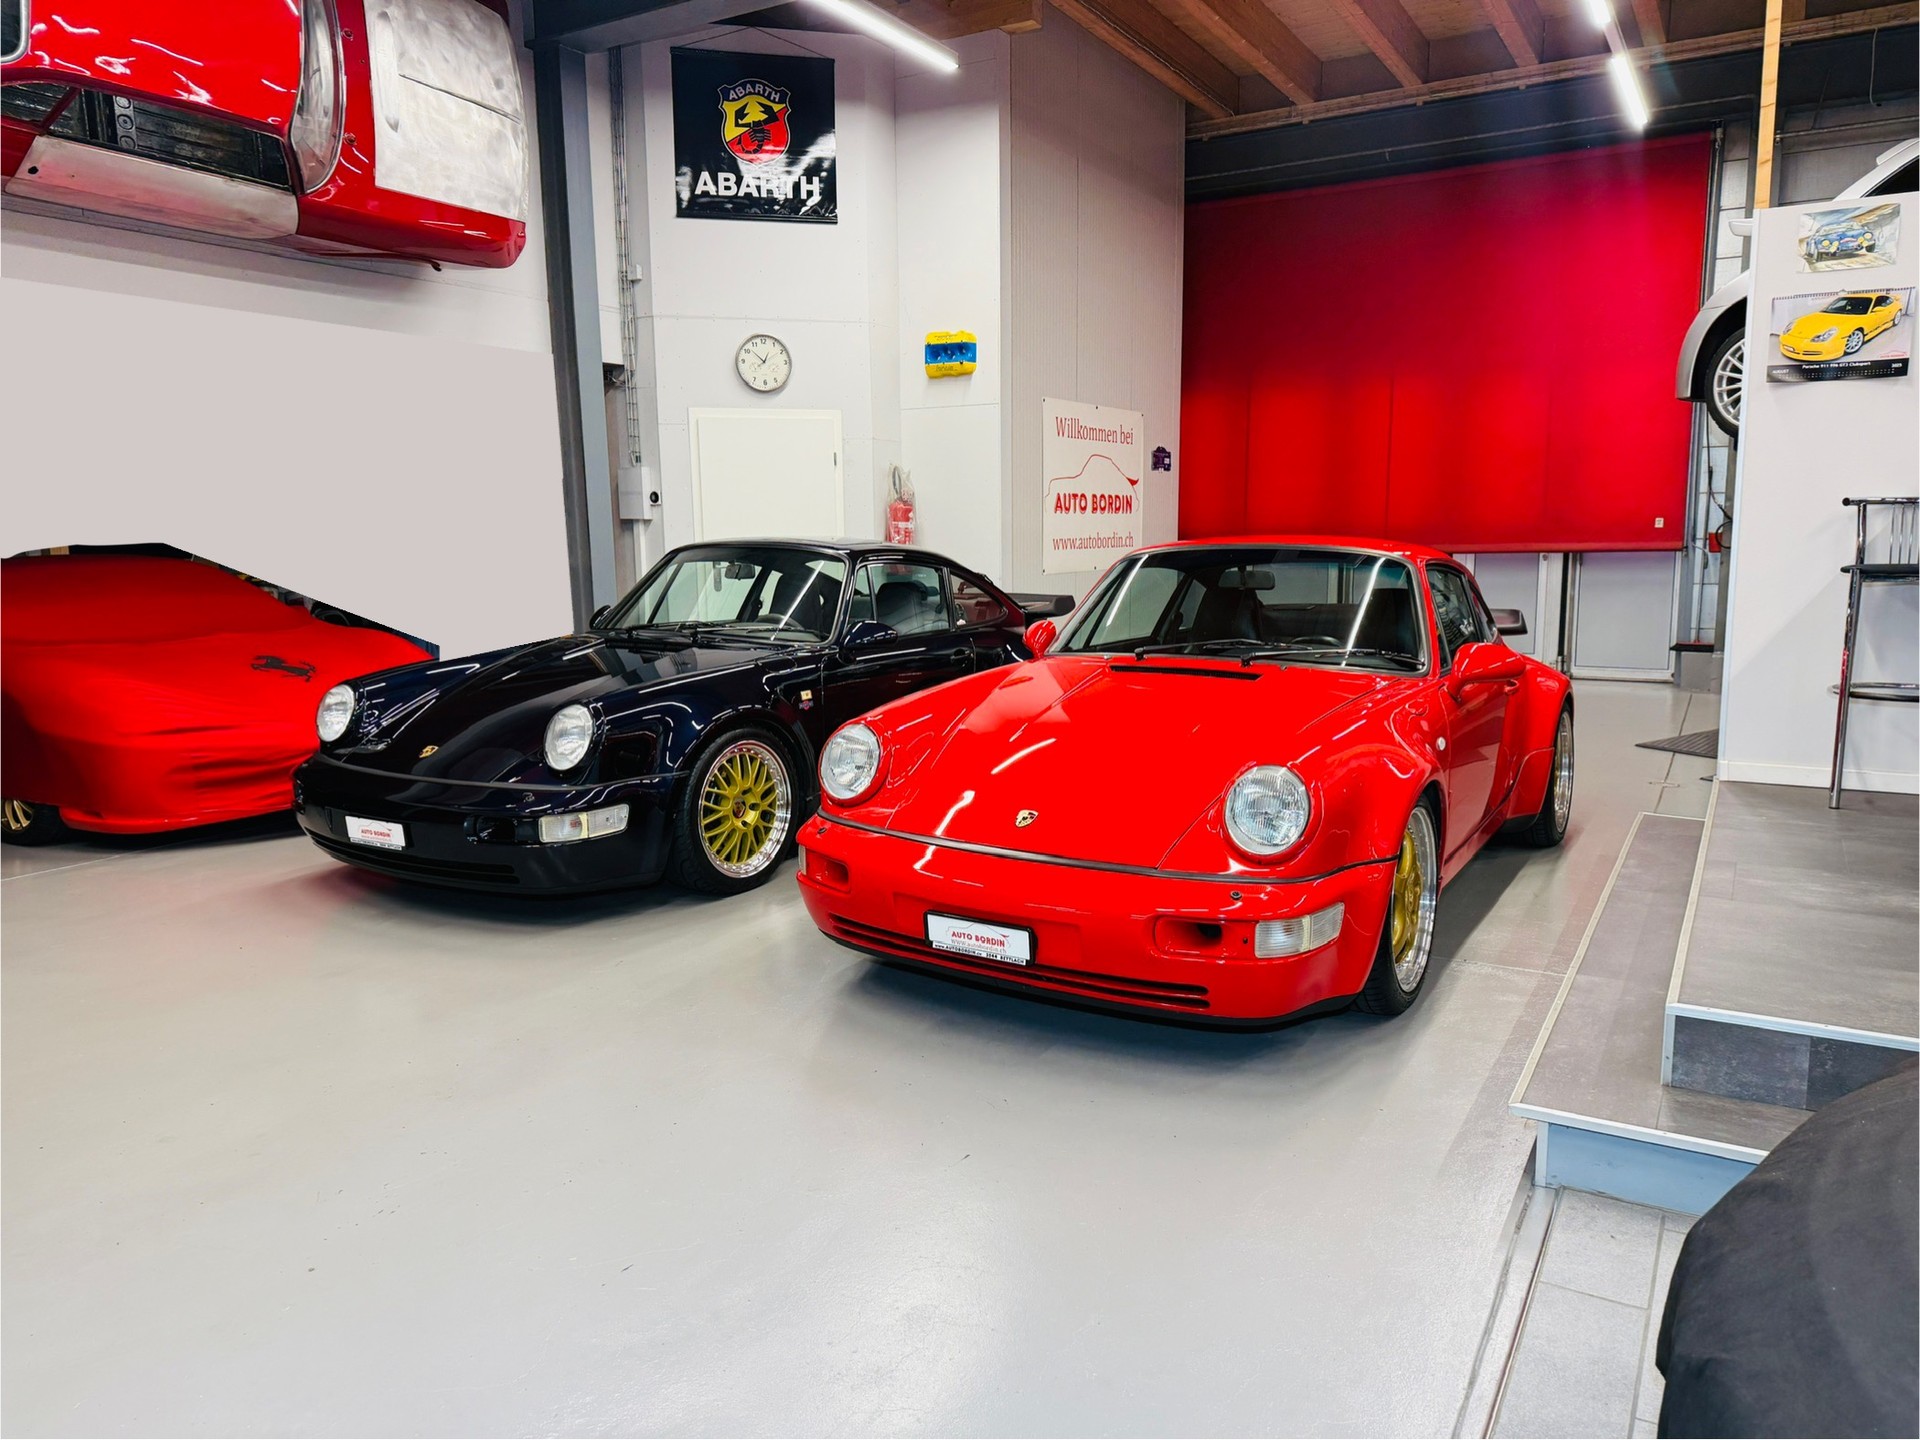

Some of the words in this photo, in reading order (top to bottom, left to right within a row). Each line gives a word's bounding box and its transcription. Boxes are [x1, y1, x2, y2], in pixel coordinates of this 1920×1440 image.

[728, 83, 781, 102] ABARTH
[694, 171, 821, 200] ABARTH
[1055, 416, 1118, 443] Willkommen
[1120, 425, 1134, 445] bei
[1054, 493, 1088, 514] AUTO
[1092, 494, 1133, 514] BORDIN
[1052, 532, 1134, 551] www.autobordin.ch
[951, 931, 973, 940] AUTO
[974, 934, 1005, 947] BORDIN
